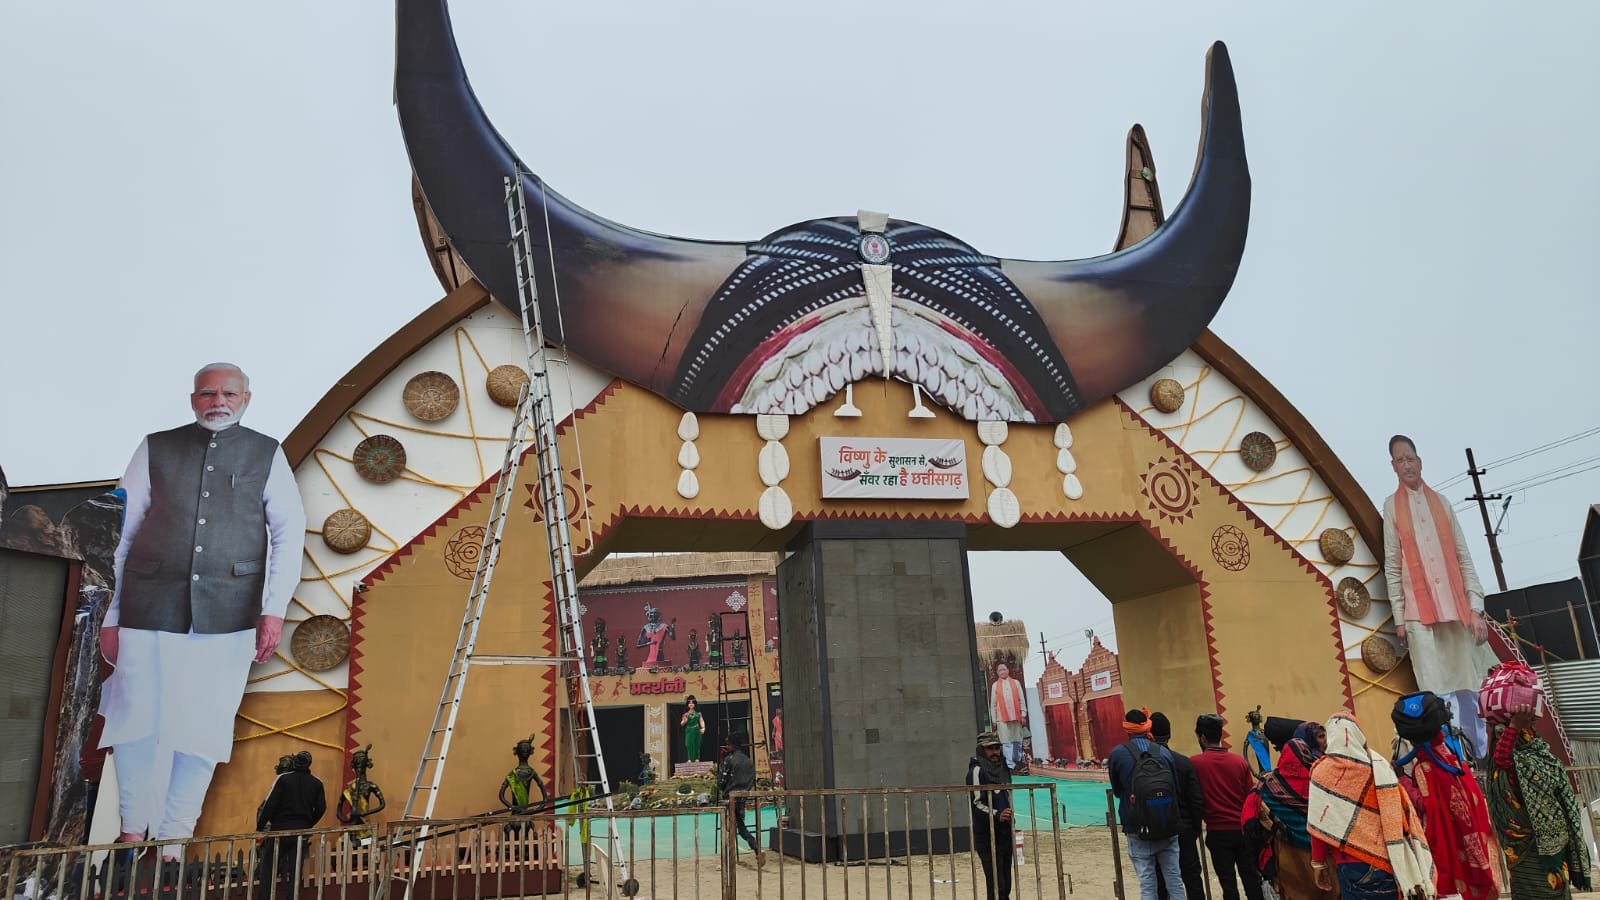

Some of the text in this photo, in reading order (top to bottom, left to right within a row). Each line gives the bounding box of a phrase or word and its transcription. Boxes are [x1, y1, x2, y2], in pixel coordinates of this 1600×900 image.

[839, 445, 871, 469] विष्णु
[874, 447, 887, 464] के
[888, 456, 917, 468] सुशासन
[859, 467, 962, 489] सँवर रहा है छत्तीसगढ़
